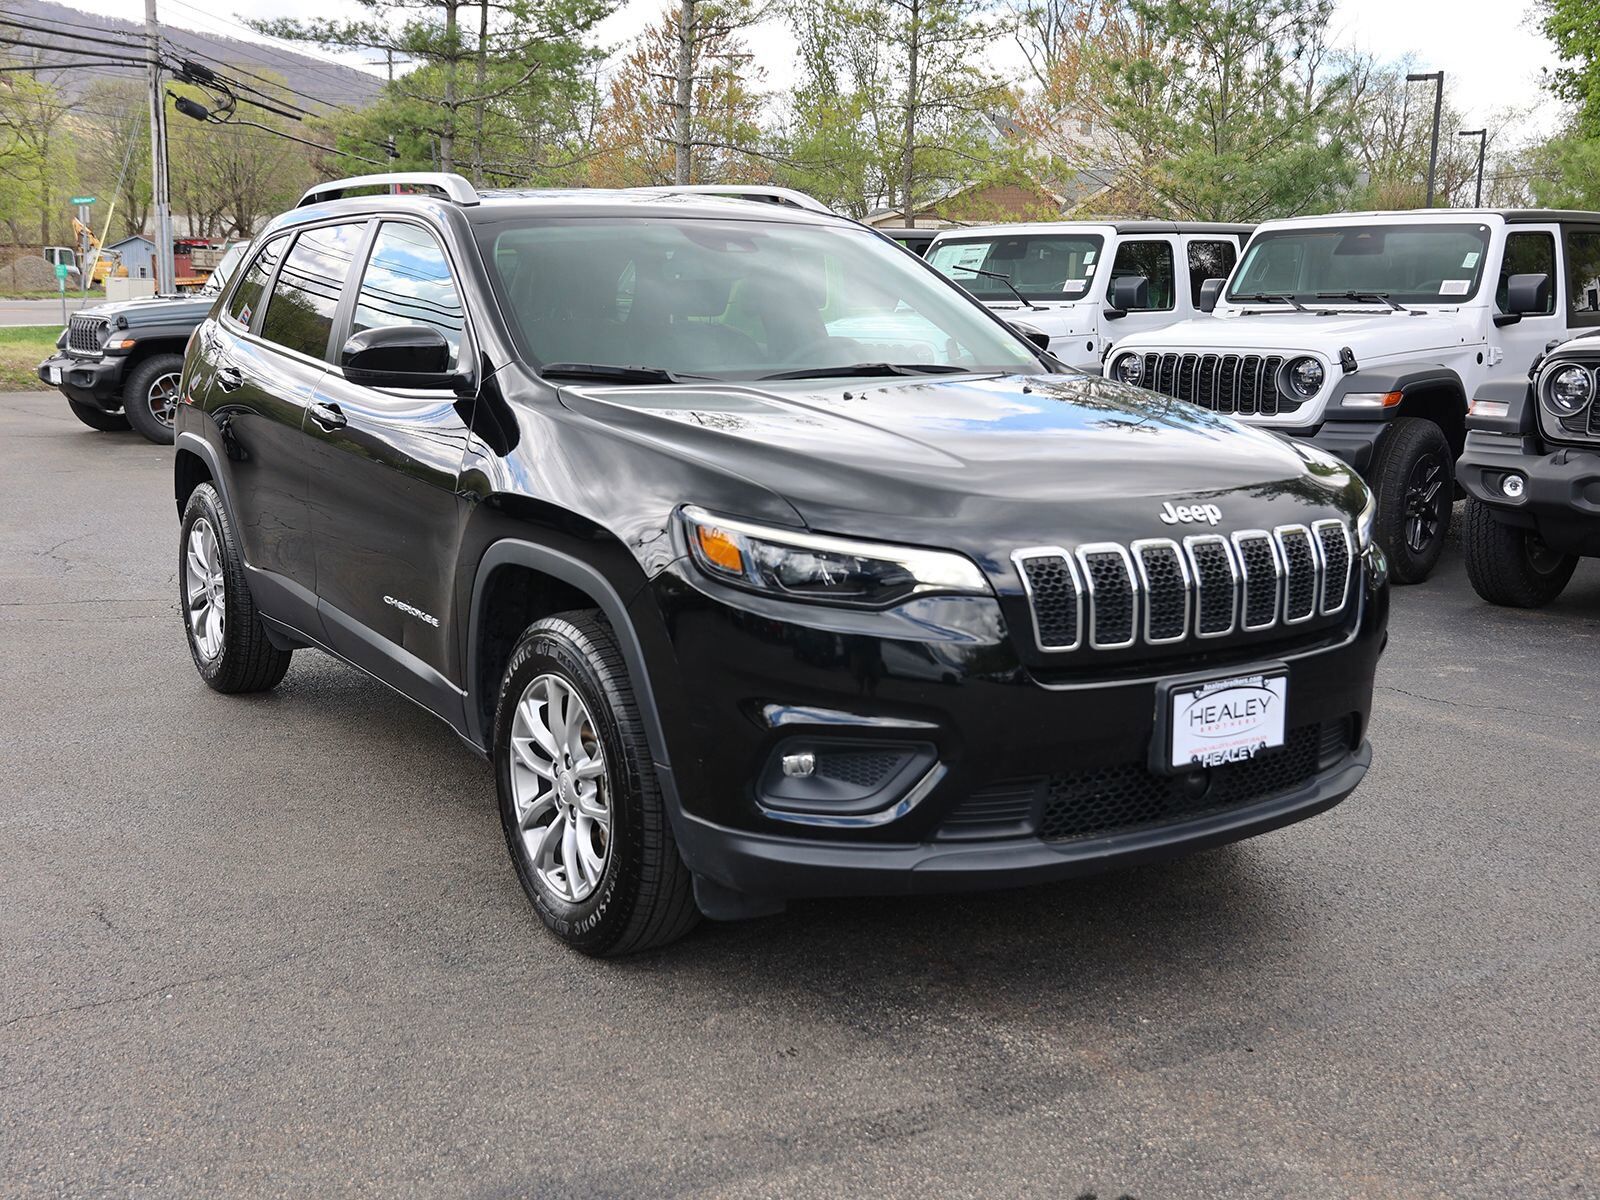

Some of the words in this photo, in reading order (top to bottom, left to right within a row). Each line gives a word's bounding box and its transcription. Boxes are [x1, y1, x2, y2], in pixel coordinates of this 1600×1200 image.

[1159, 501, 1222, 526] Jeep
[383, 595, 441, 628] CHEROKEE
[1190, 695, 1272, 727] HEALEY
[1202, 744, 1257, 768] HEALEY
